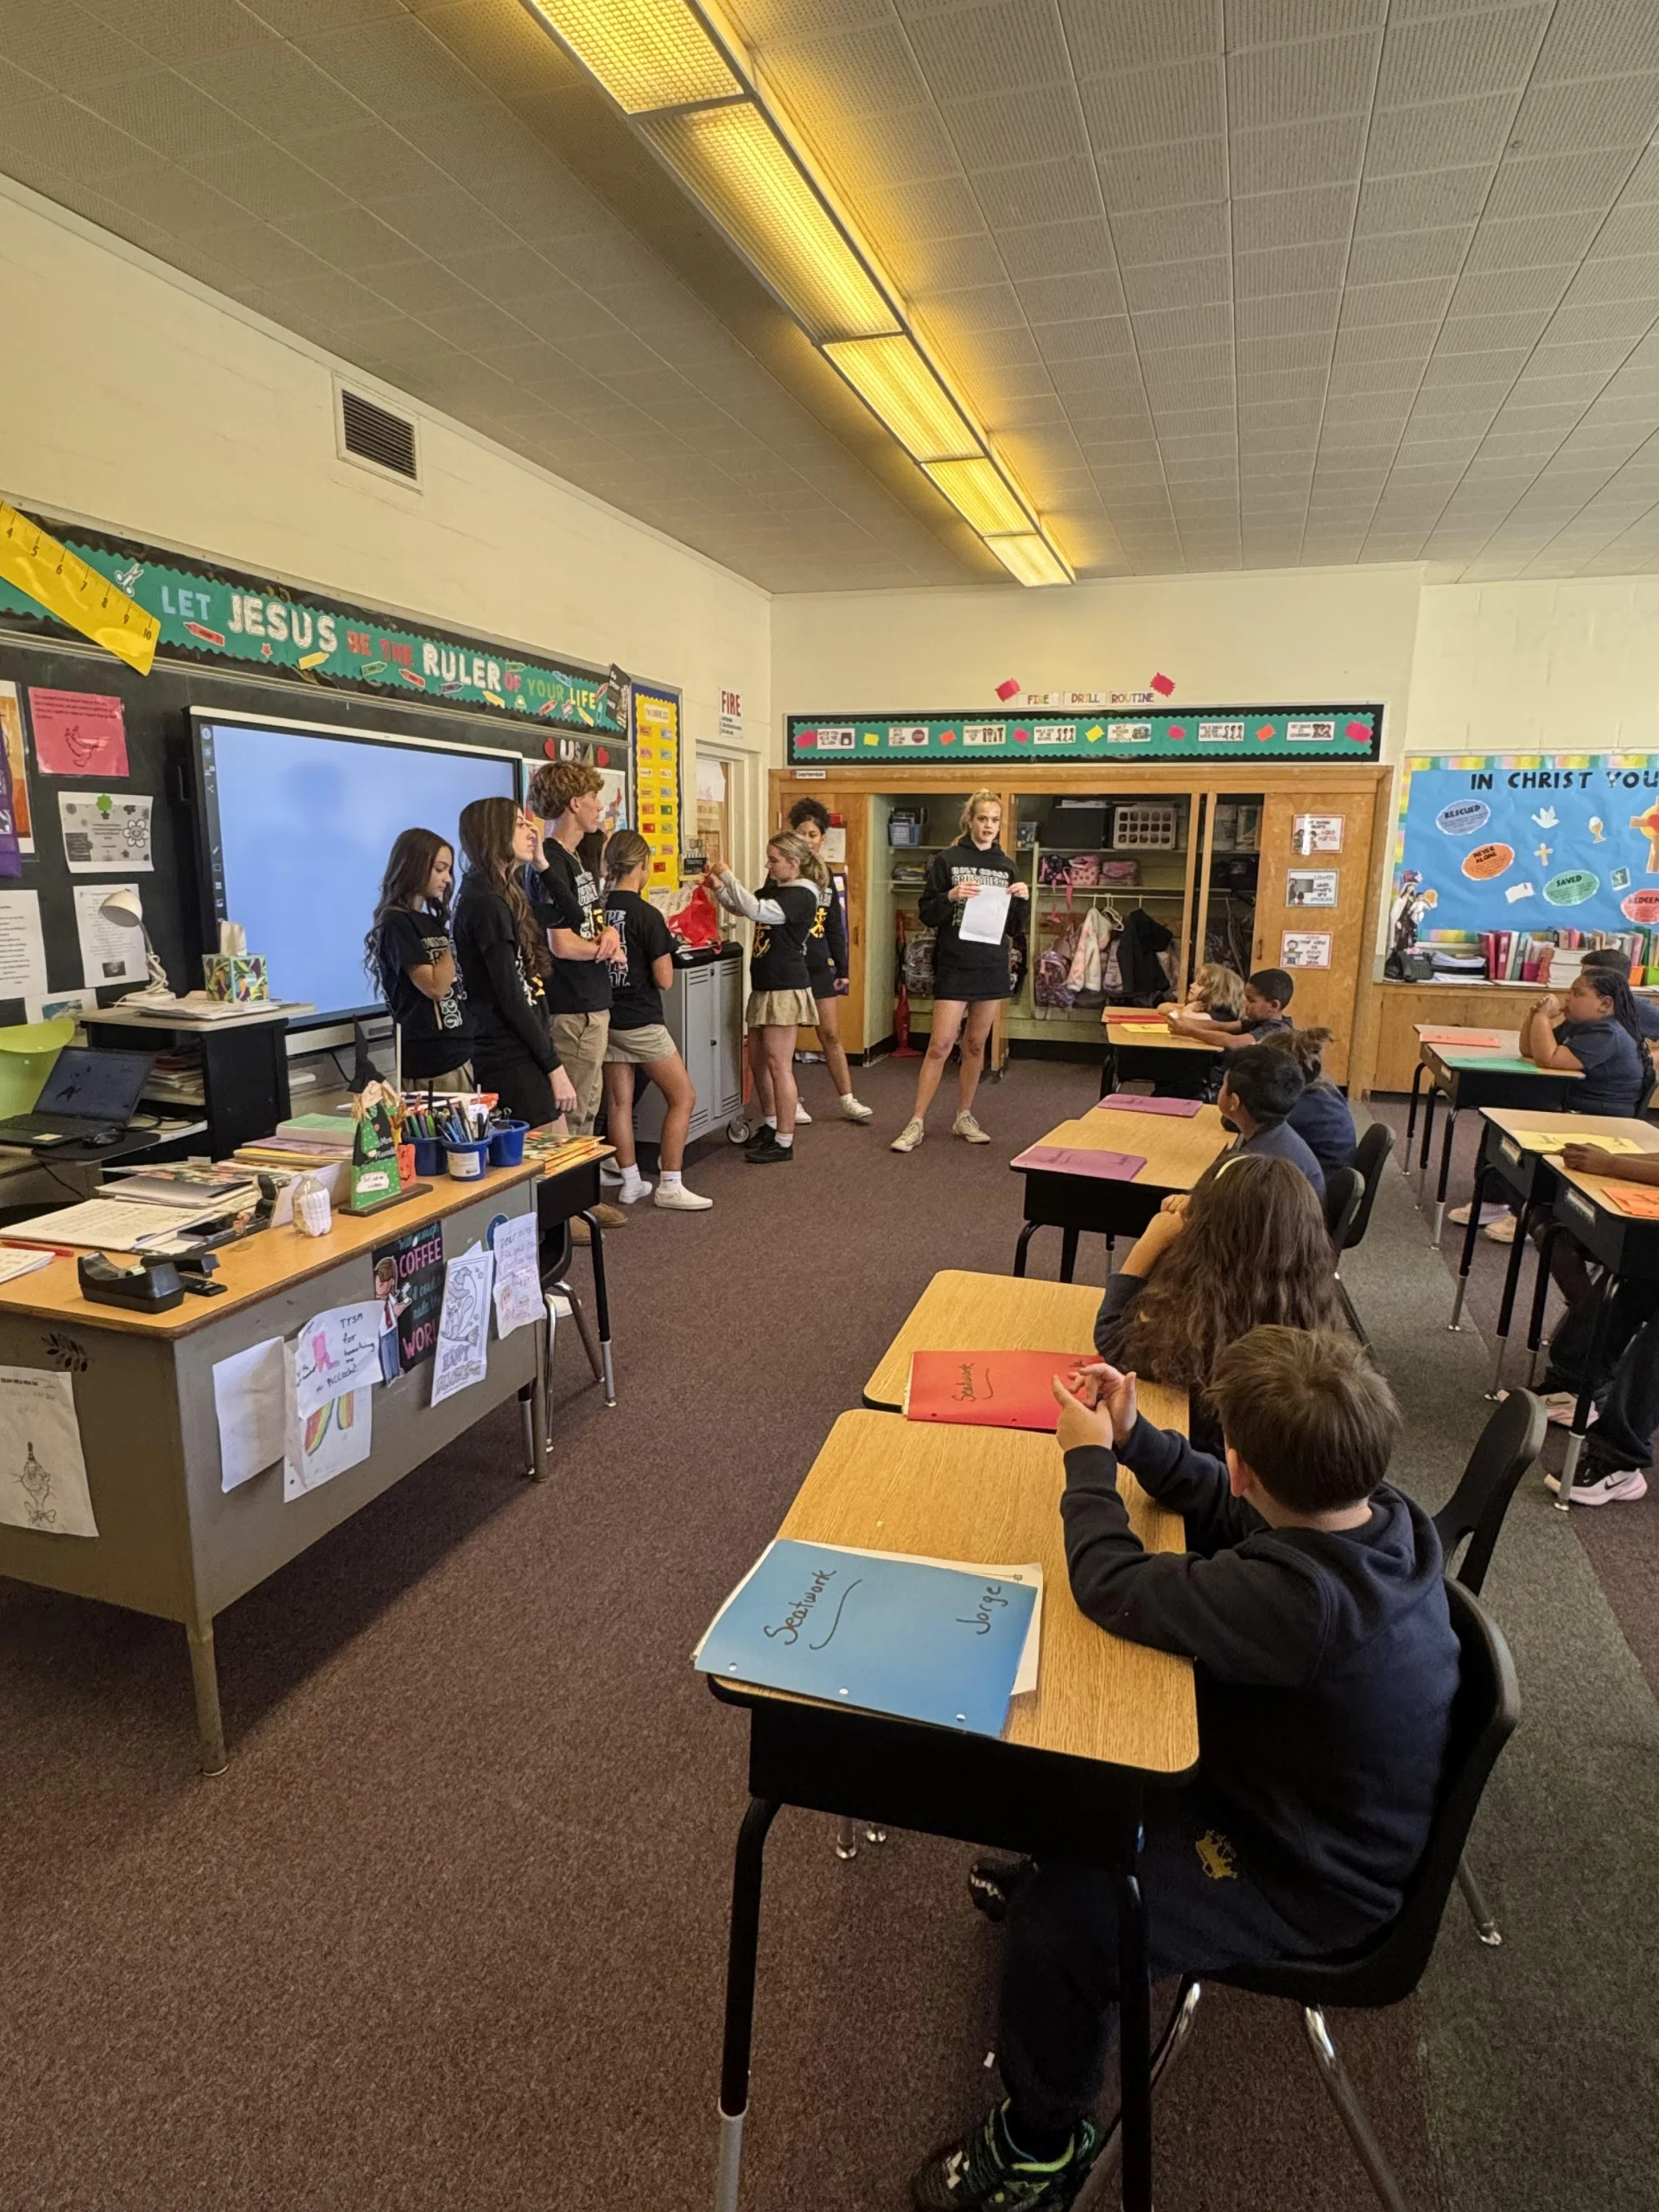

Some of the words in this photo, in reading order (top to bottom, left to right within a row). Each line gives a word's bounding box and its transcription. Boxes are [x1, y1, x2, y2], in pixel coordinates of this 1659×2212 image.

[6, 527, 13, 538] 4
[30, 546, 39, 556] 5
[56, 564, 62, 575] 6
[80, 581, 87, 591] 7
[101, 597, 108, 608] 8
[124, 613, 129, 624] 9
[143, 629, 151, 640] 10
[161, 585, 211, 620] LET
[228, 592, 338, 653] JESUS
[347, 630, 372, 657] BE
[379, 638, 414, 667] THE
[423, 642, 502, 692] RULER
[504, 671, 521, 692] OF
[527, 678, 564, 701] YOUR
[570, 688, 596, 709] LIFE
[721, 690, 741, 717] FIRE
[1111, 693, 1154, 703] ROUTINE
[560, 739, 594, 766] USA
[1471, 773, 1493, 790] IN
[1507, 771, 1592, 789] CHRIST
[1444, 804, 1481, 819] RESCUED
[1472, 846, 1495, 858] NEVER
[1476, 851, 1497, 864] ALONE
[950, 867, 977, 875] HOLY
[1556, 874, 1582, 887] SAVED
[399, 1237, 442, 1278] COFFEE
[343, 1332, 356, 1344] for
[402, 1319, 436, 1360] WORL
[951, 1363, 976, 1402] Seatwork
[763, 1569, 837, 1645] Seatwork
[955, 1585, 1009, 1636] Jorge
